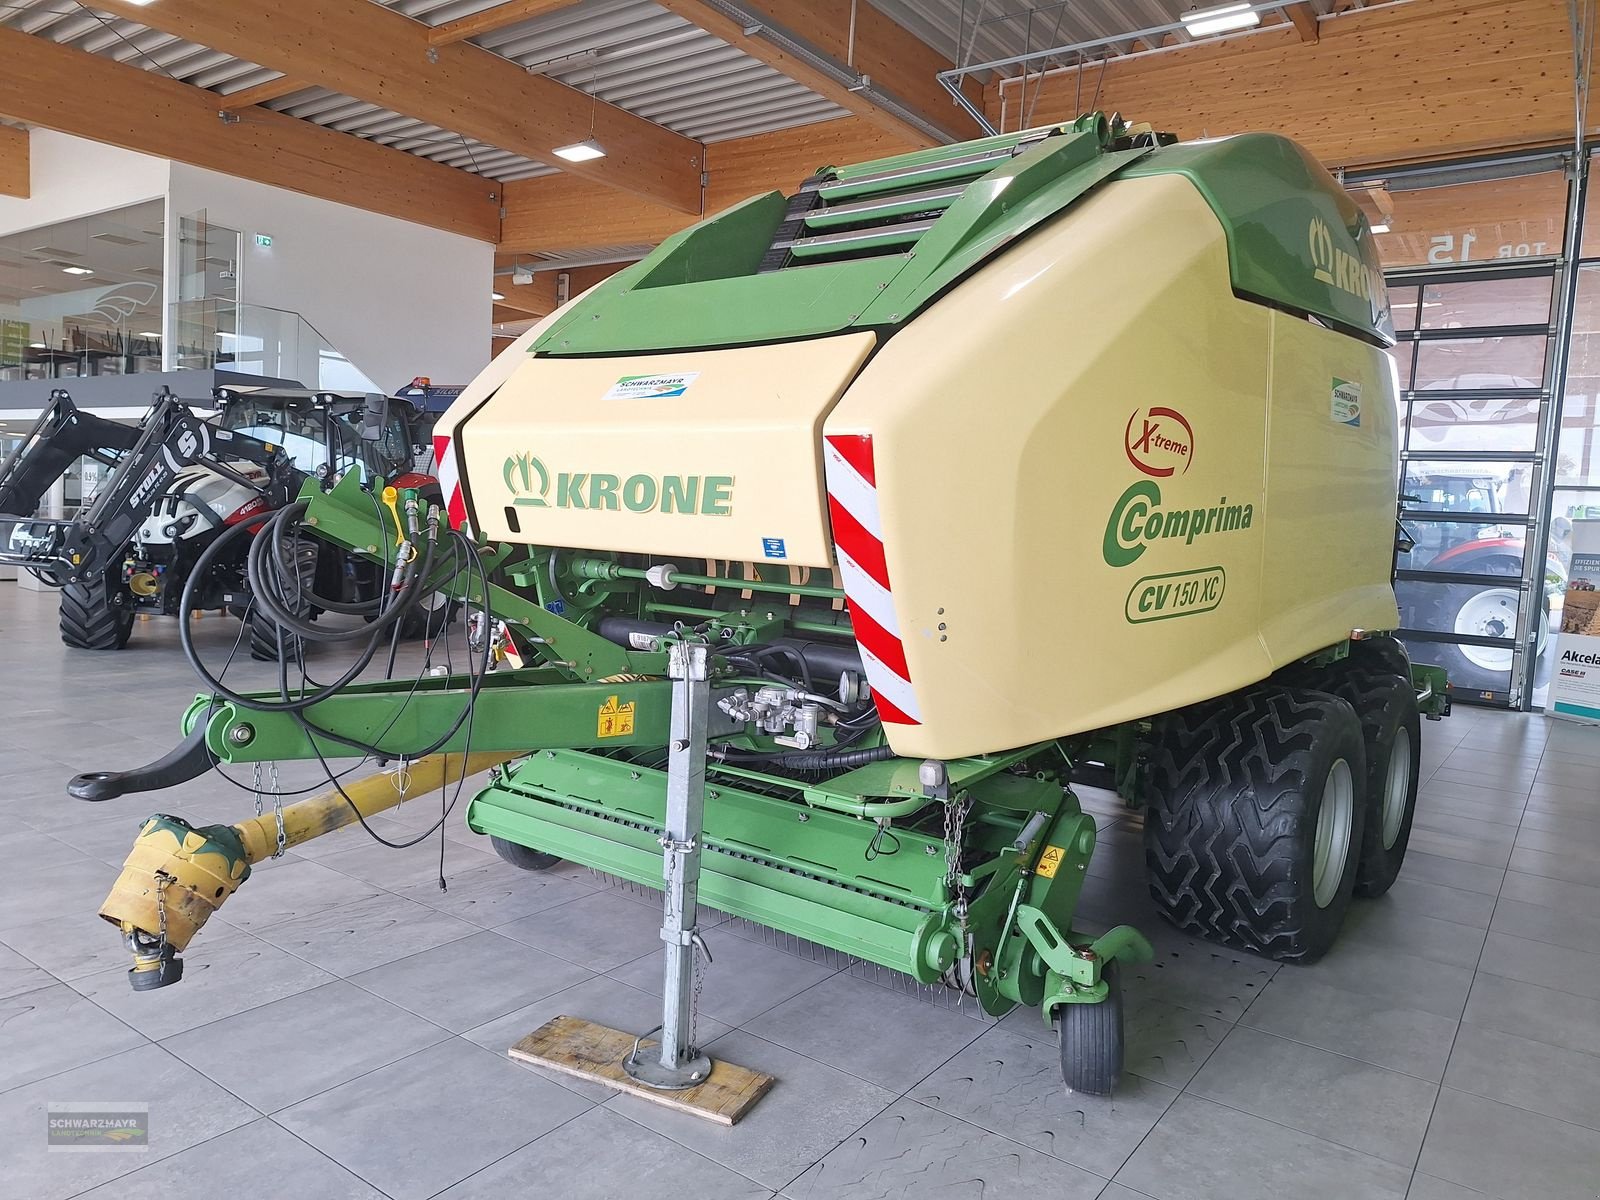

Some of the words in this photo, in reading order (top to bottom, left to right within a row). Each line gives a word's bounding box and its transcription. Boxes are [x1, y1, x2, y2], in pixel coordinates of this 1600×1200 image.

[620, 378, 684, 388] SCHWARZMAYR
[1131, 419, 1188, 456] X-treme
[129, 461, 165, 509] STOLL
[556, 472, 735, 517] KRONE
[1138, 584, 1172, 613] CV
[1172, 580, 1199, 608] 150
[1199, 576, 1219, 603] XC
